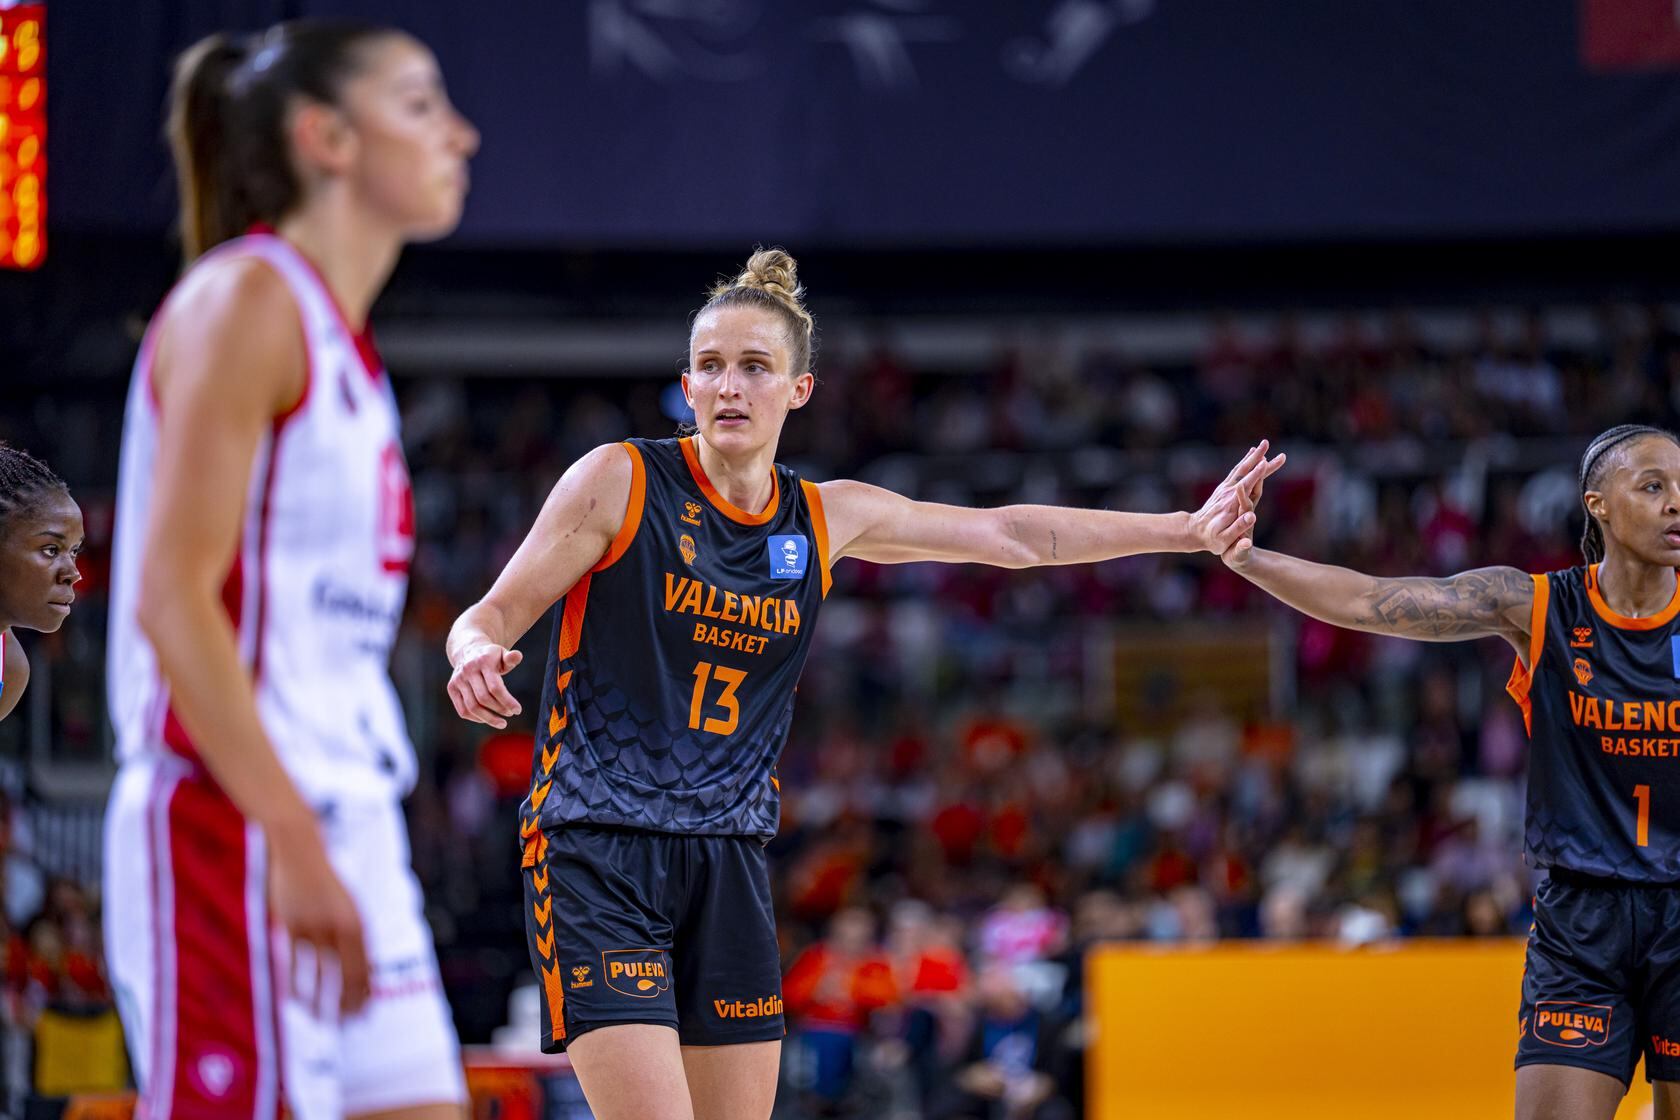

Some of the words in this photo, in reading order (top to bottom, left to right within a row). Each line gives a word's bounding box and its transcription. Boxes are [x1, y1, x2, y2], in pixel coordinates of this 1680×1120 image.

[664, 572, 801, 635] VALENCIA
[692, 622, 769, 655] BASKET
[688, 660, 749, 736] 13
[1568, 690, 1680, 732] VALENC
[1601, 736, 1680, 757] BASKET
[1632, 783, 1650, 847] 1
[609, 961, 665, 979] PULEVA
[570, 980, 593, 989] hummel
[713, 994, 784, 1018] Vitaldin
[1538, 1010, 1604, 1033] PULEVA
